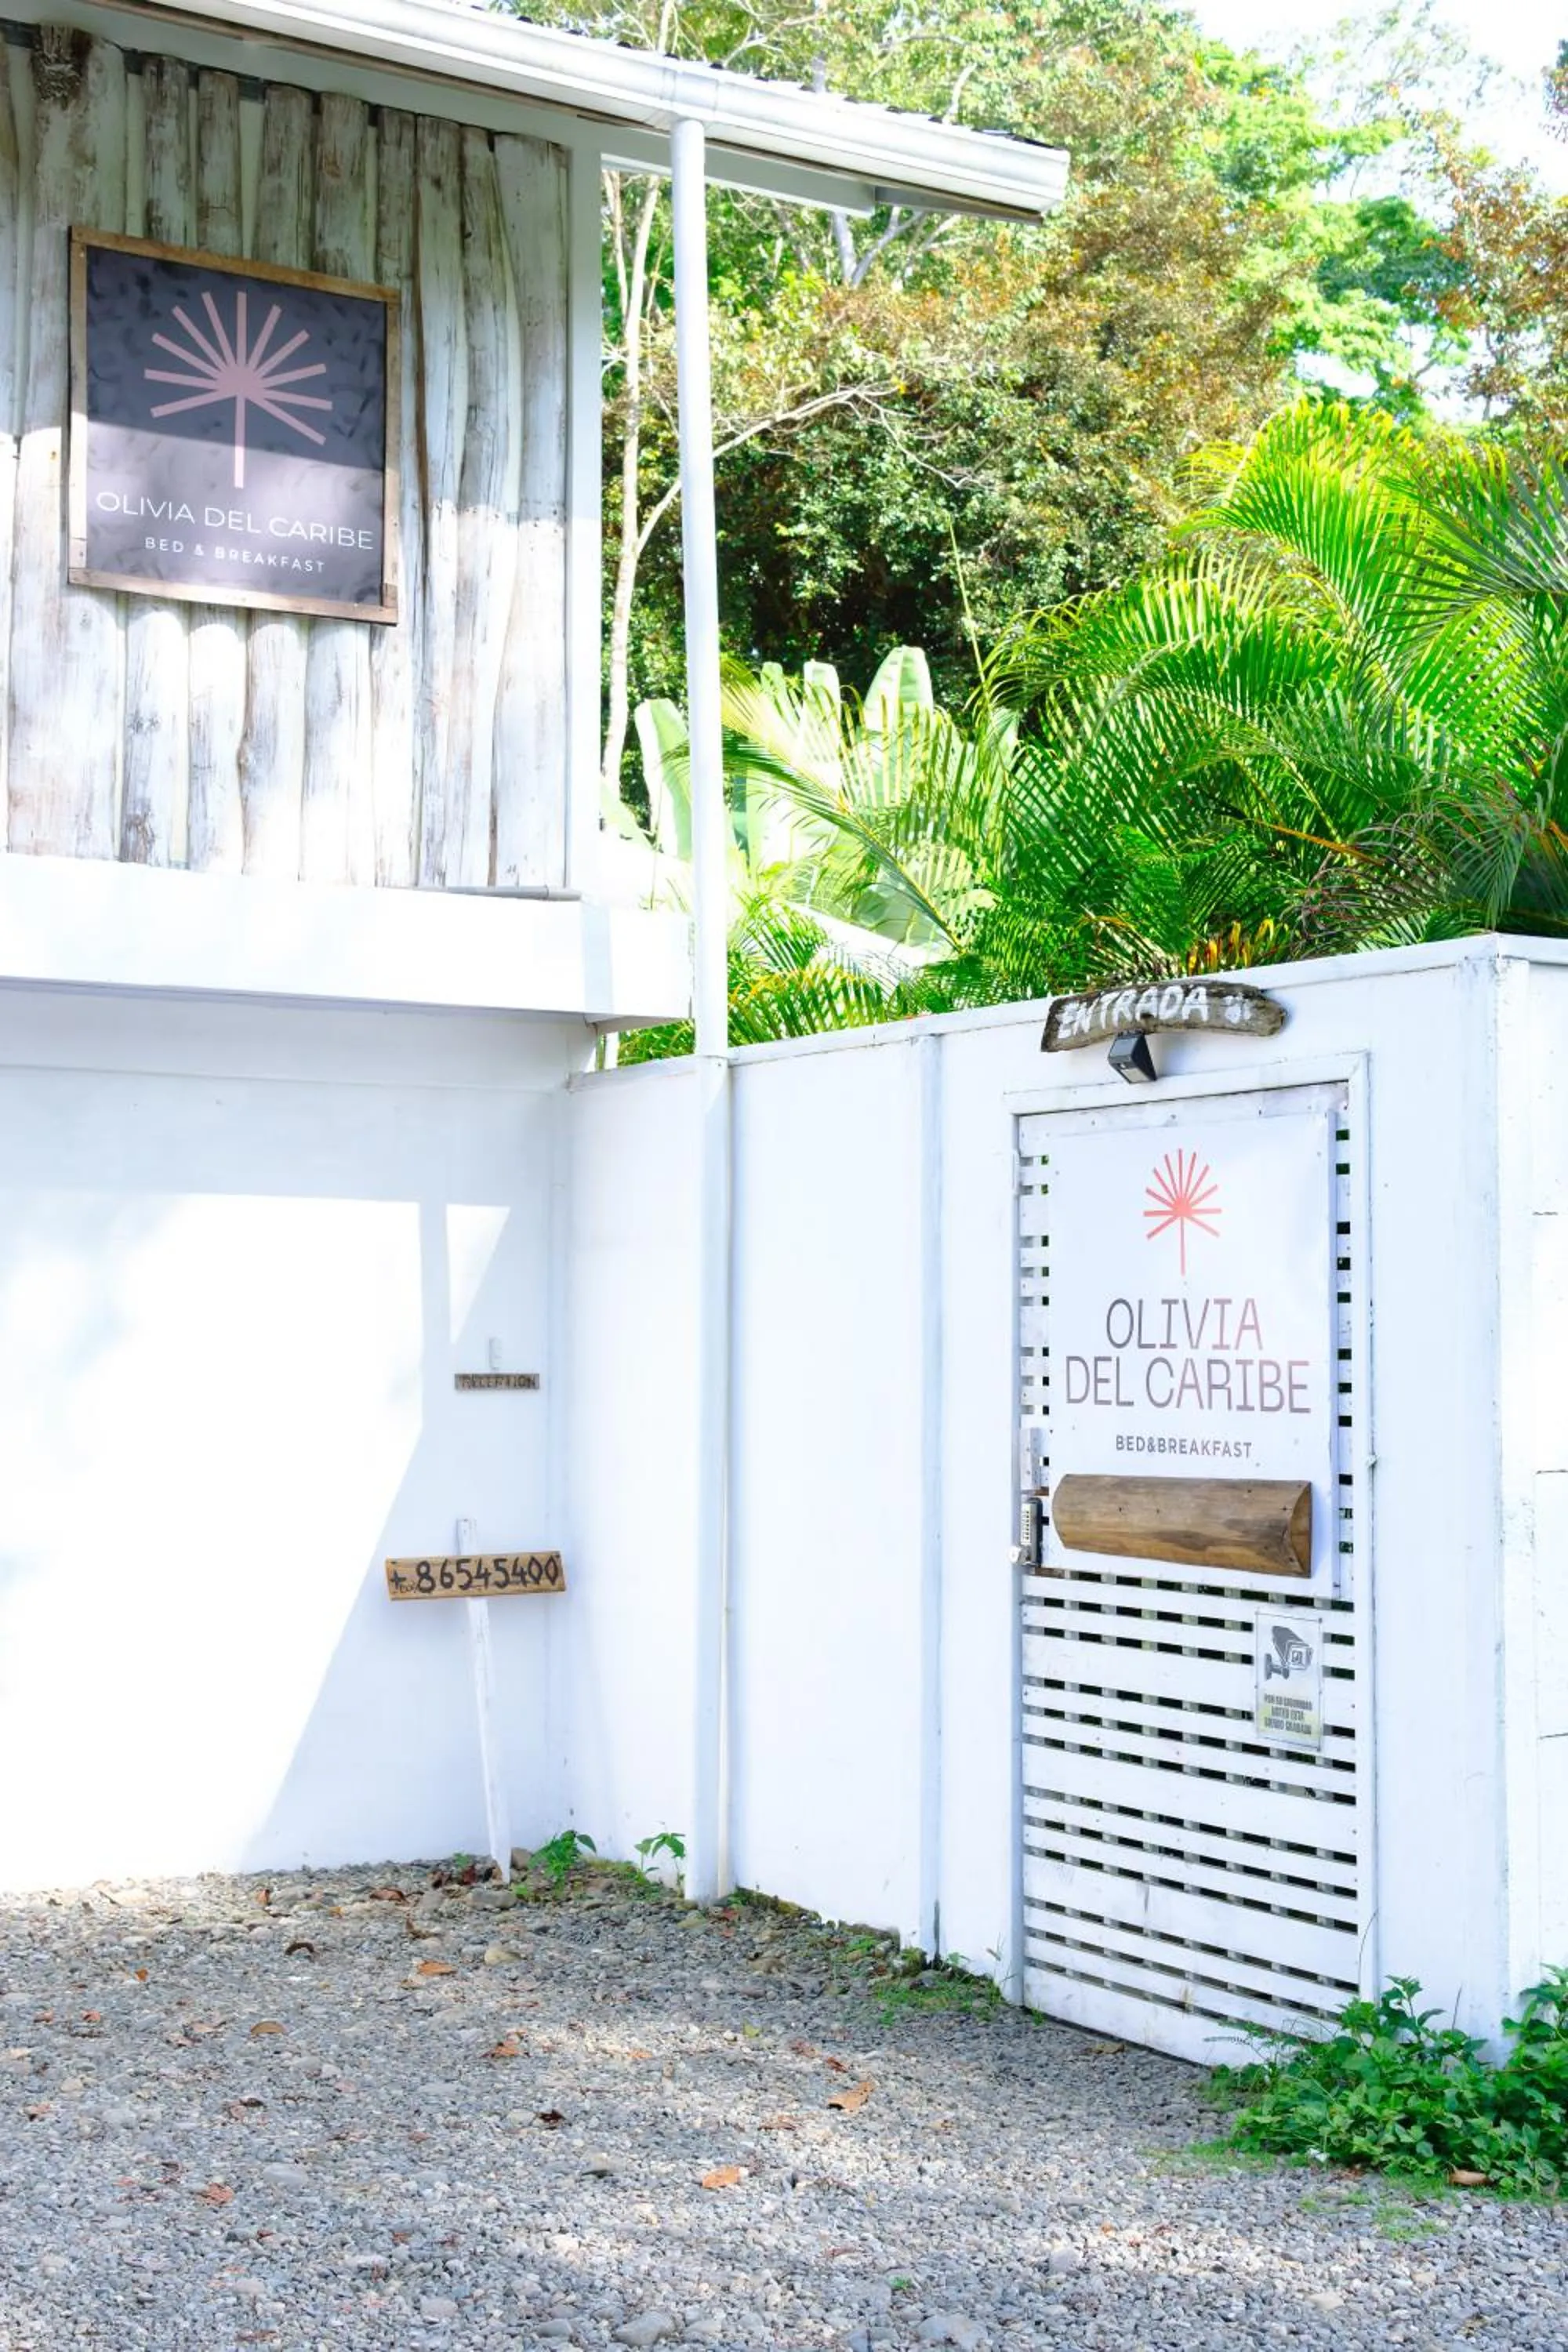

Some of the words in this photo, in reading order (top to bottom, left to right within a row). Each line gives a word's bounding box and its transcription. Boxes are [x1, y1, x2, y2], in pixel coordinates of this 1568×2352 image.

[95, 492, 196, 524] OLIVIA
[204, 507, 261, 535] DEL
[268, 517, 375, 550] CARIBE
[145, 537, 183, 553] BED
[193, 545, 205, 557] &
[215, 546, 325, 573] BREAKFAST
[1057, 985, 1209, 1040] ENTRADA
[1105, 1298, 1264, 1350] OLIVIA
[1065, 1356, 1134, 1406] DEL
[1145, 1356, 1312, 1414] CARIBE
[1116, 1436, 1253, 1459] BED&BREAKFAST
